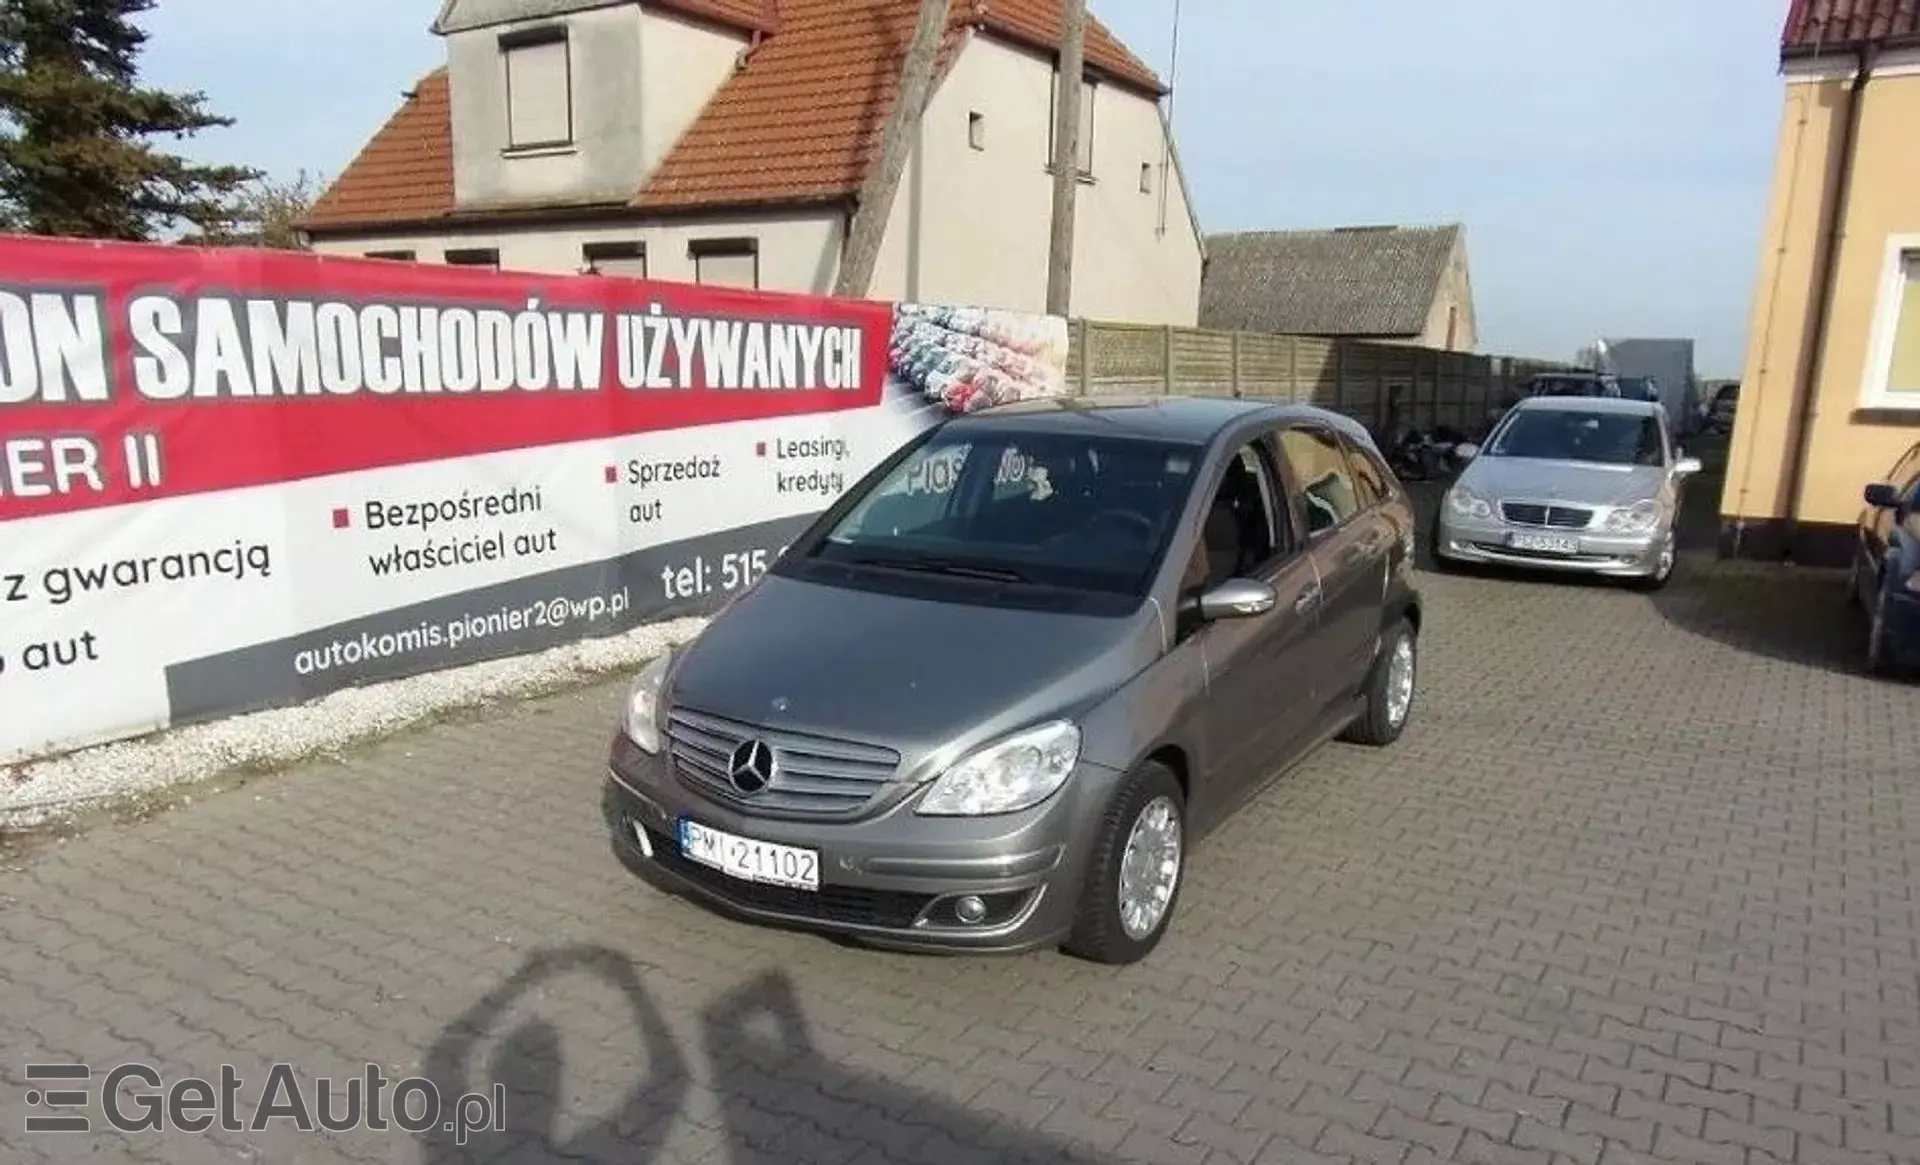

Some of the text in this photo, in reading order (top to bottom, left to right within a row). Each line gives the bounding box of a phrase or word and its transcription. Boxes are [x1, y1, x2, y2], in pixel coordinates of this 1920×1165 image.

[129, 294, 604, 399] SAMOCHODÓW
[616, 302, 862, 390] UŻYWANYCH
[0, 436, 104, 497] ER
[628, 454, 722, 489] Sprzedaż
[777, 470, 844, 496] kredyty
[365, 484, 543, 532] Bezpośredni
[630, 498, 662, 523] aut
[4, 539, 272, 605] z gwarancją
[368, 527, 558, 578] właściciel aut
[661, 555, 712, 600] tel:
[22, 630, 99, 671] aut
[294, 586, 630, 676] autokomis.pionier2@wp.pl
[736, 840, 815, 881] 21102
